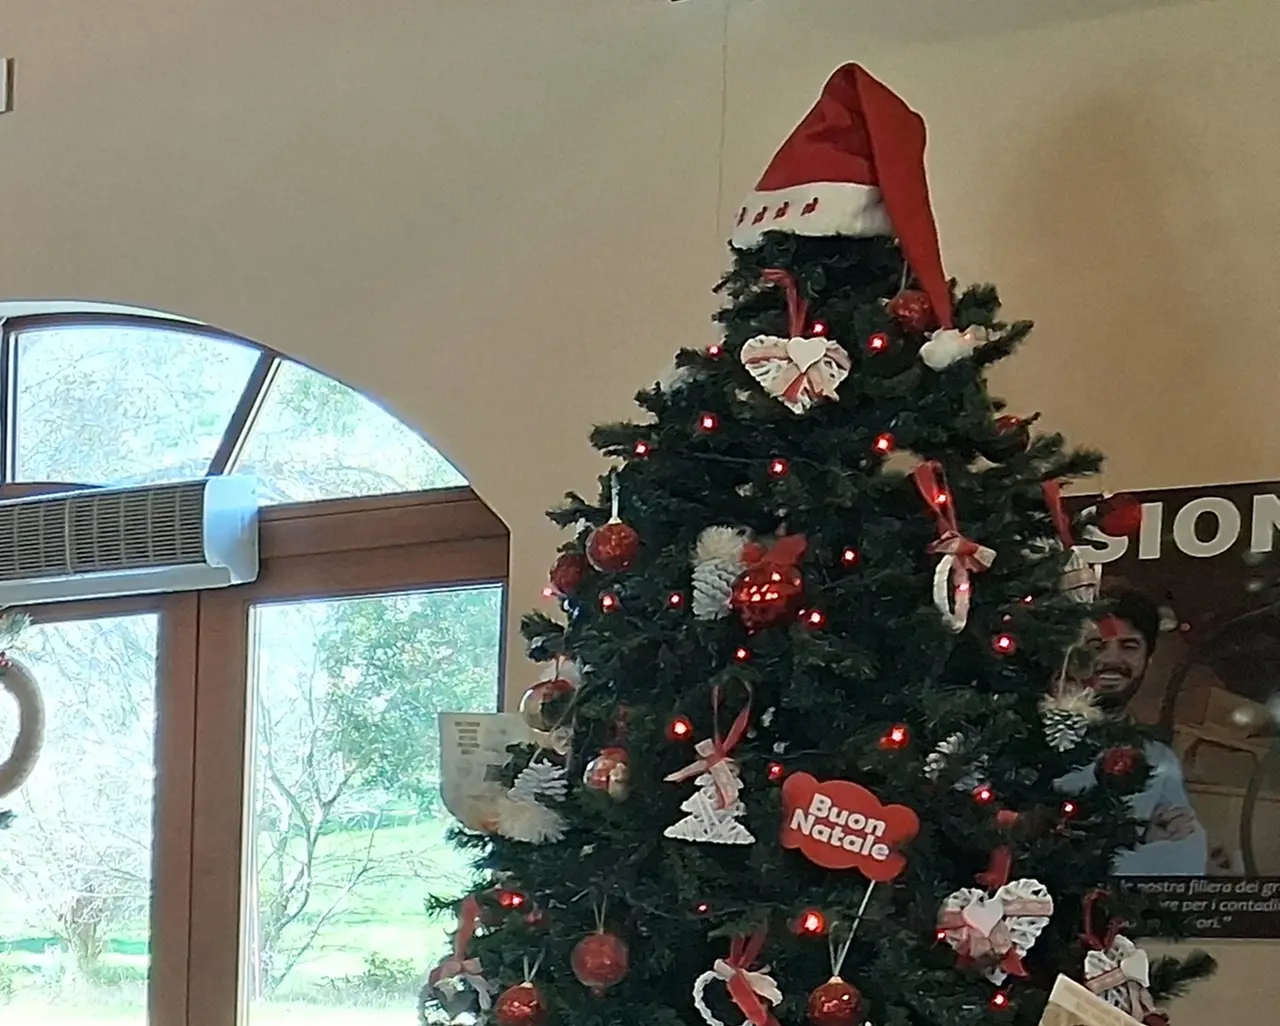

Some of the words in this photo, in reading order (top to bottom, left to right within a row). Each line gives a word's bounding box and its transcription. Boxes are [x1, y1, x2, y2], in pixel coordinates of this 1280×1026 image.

[808, 792, 886, 837] Buon
[790, 808, 890, 861] Natale
[1188, 878, 1231, 895] filiera
[1235, 880, 1259, 893] dei
[1182, 900, 1207, 912] per
